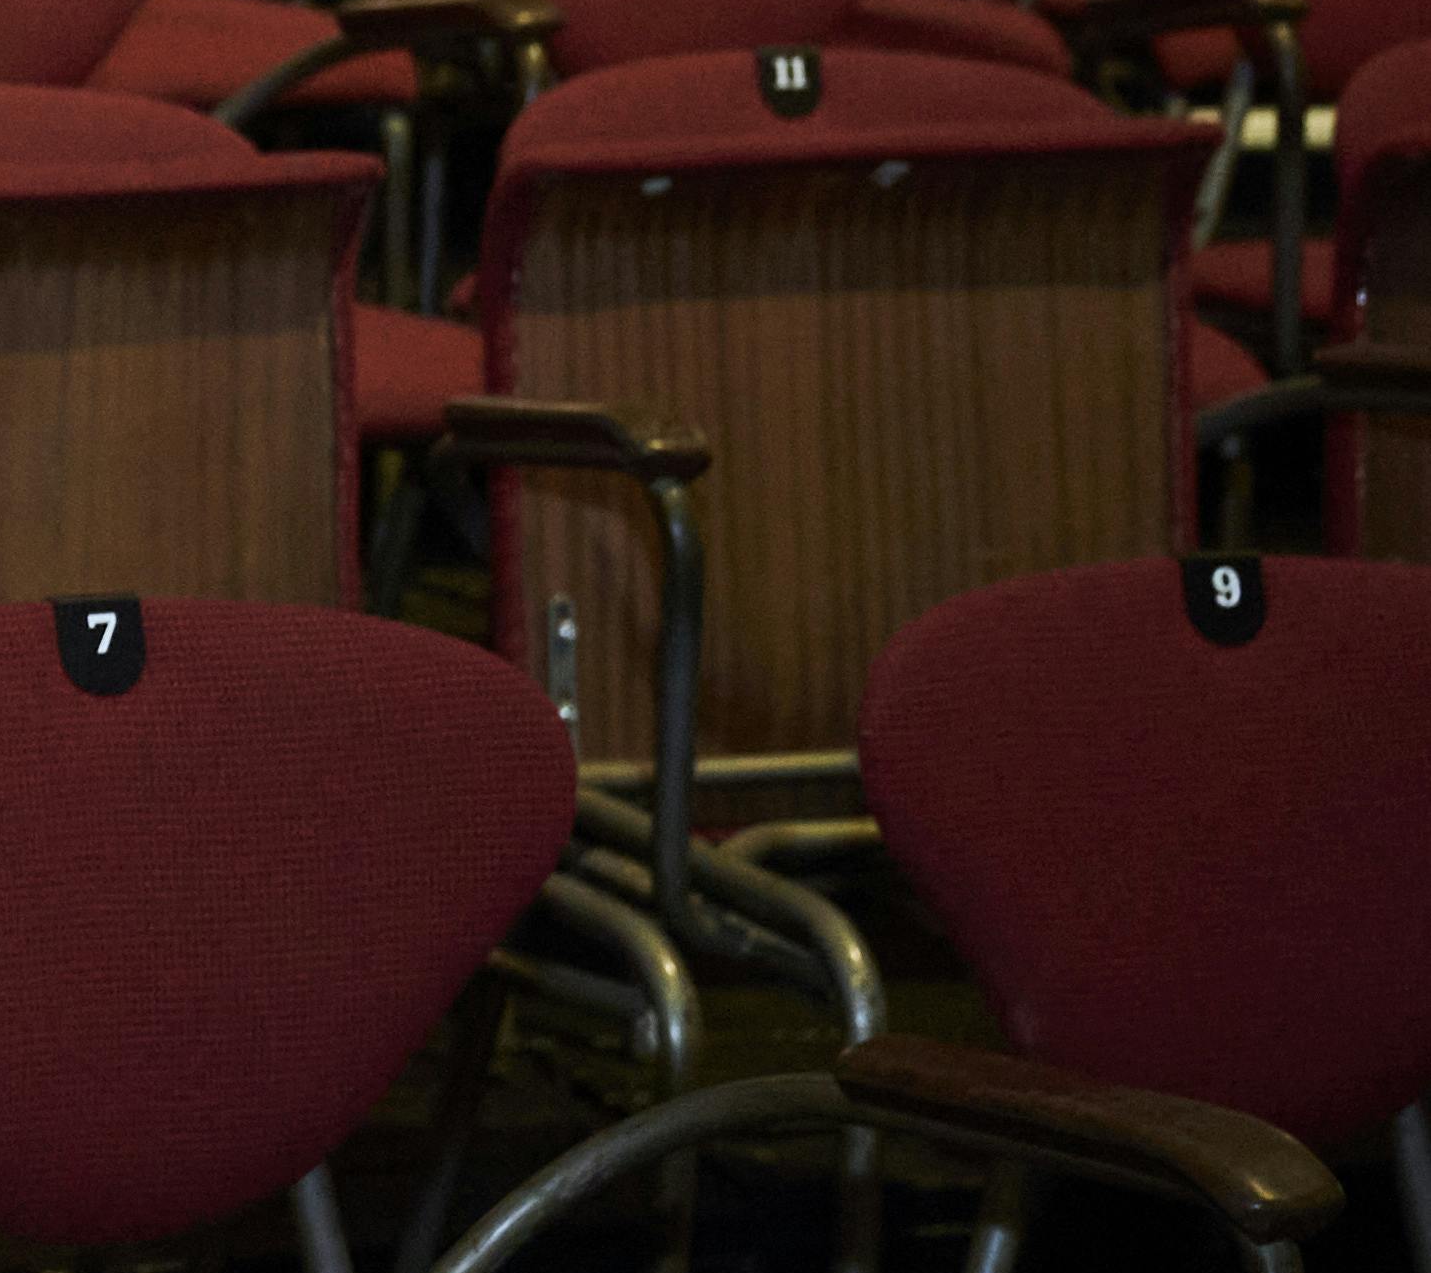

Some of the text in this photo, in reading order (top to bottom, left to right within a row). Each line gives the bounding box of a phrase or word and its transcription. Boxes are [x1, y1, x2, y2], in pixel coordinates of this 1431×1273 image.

[774, 56, 806, 90] 11
[1211, 565, 1241, 609] 9
[87, 612, 117, 654] 7
